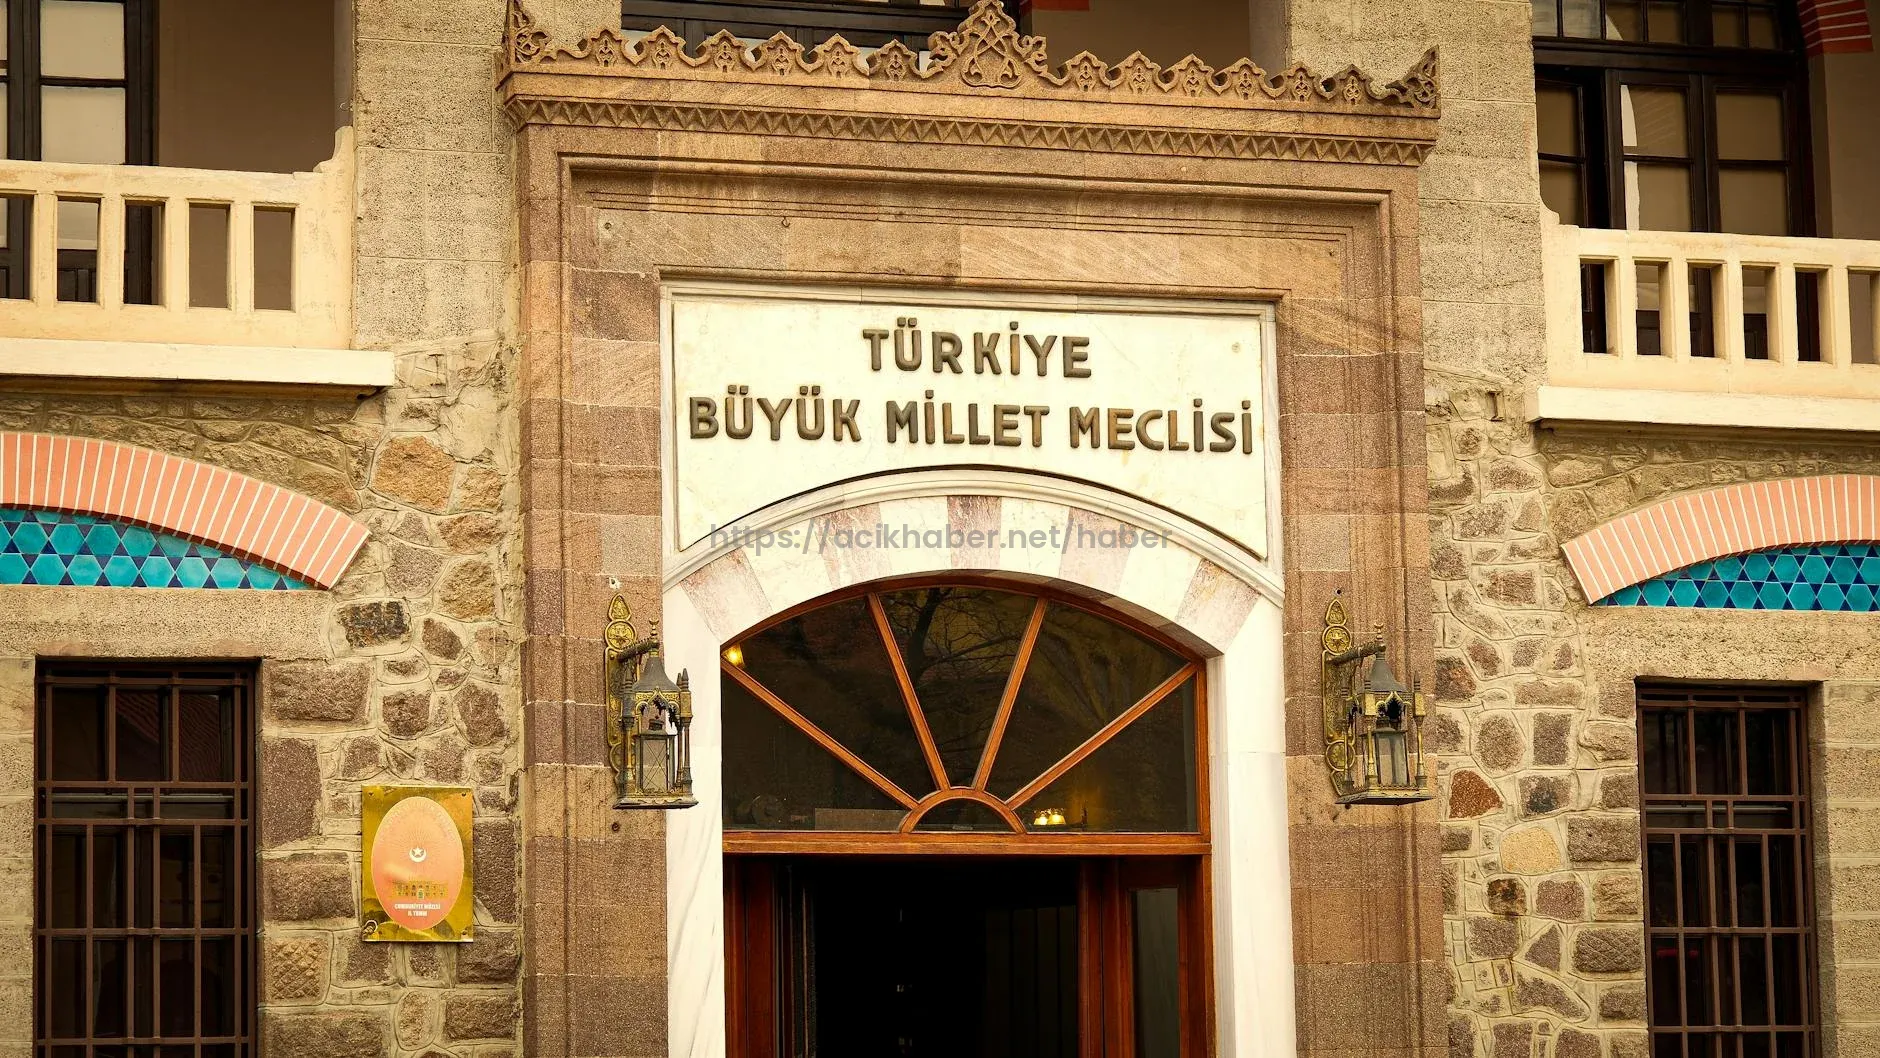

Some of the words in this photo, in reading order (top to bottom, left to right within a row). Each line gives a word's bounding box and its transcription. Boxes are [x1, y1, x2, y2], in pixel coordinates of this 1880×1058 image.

[862, 317, 1092, 378] TÜRKİYE
[689, 384, 862, 442] BÜYÜK
[886, 389, 1050, 448] MİLLET
[1069, 398, 1253, 455] MECLİSİ
